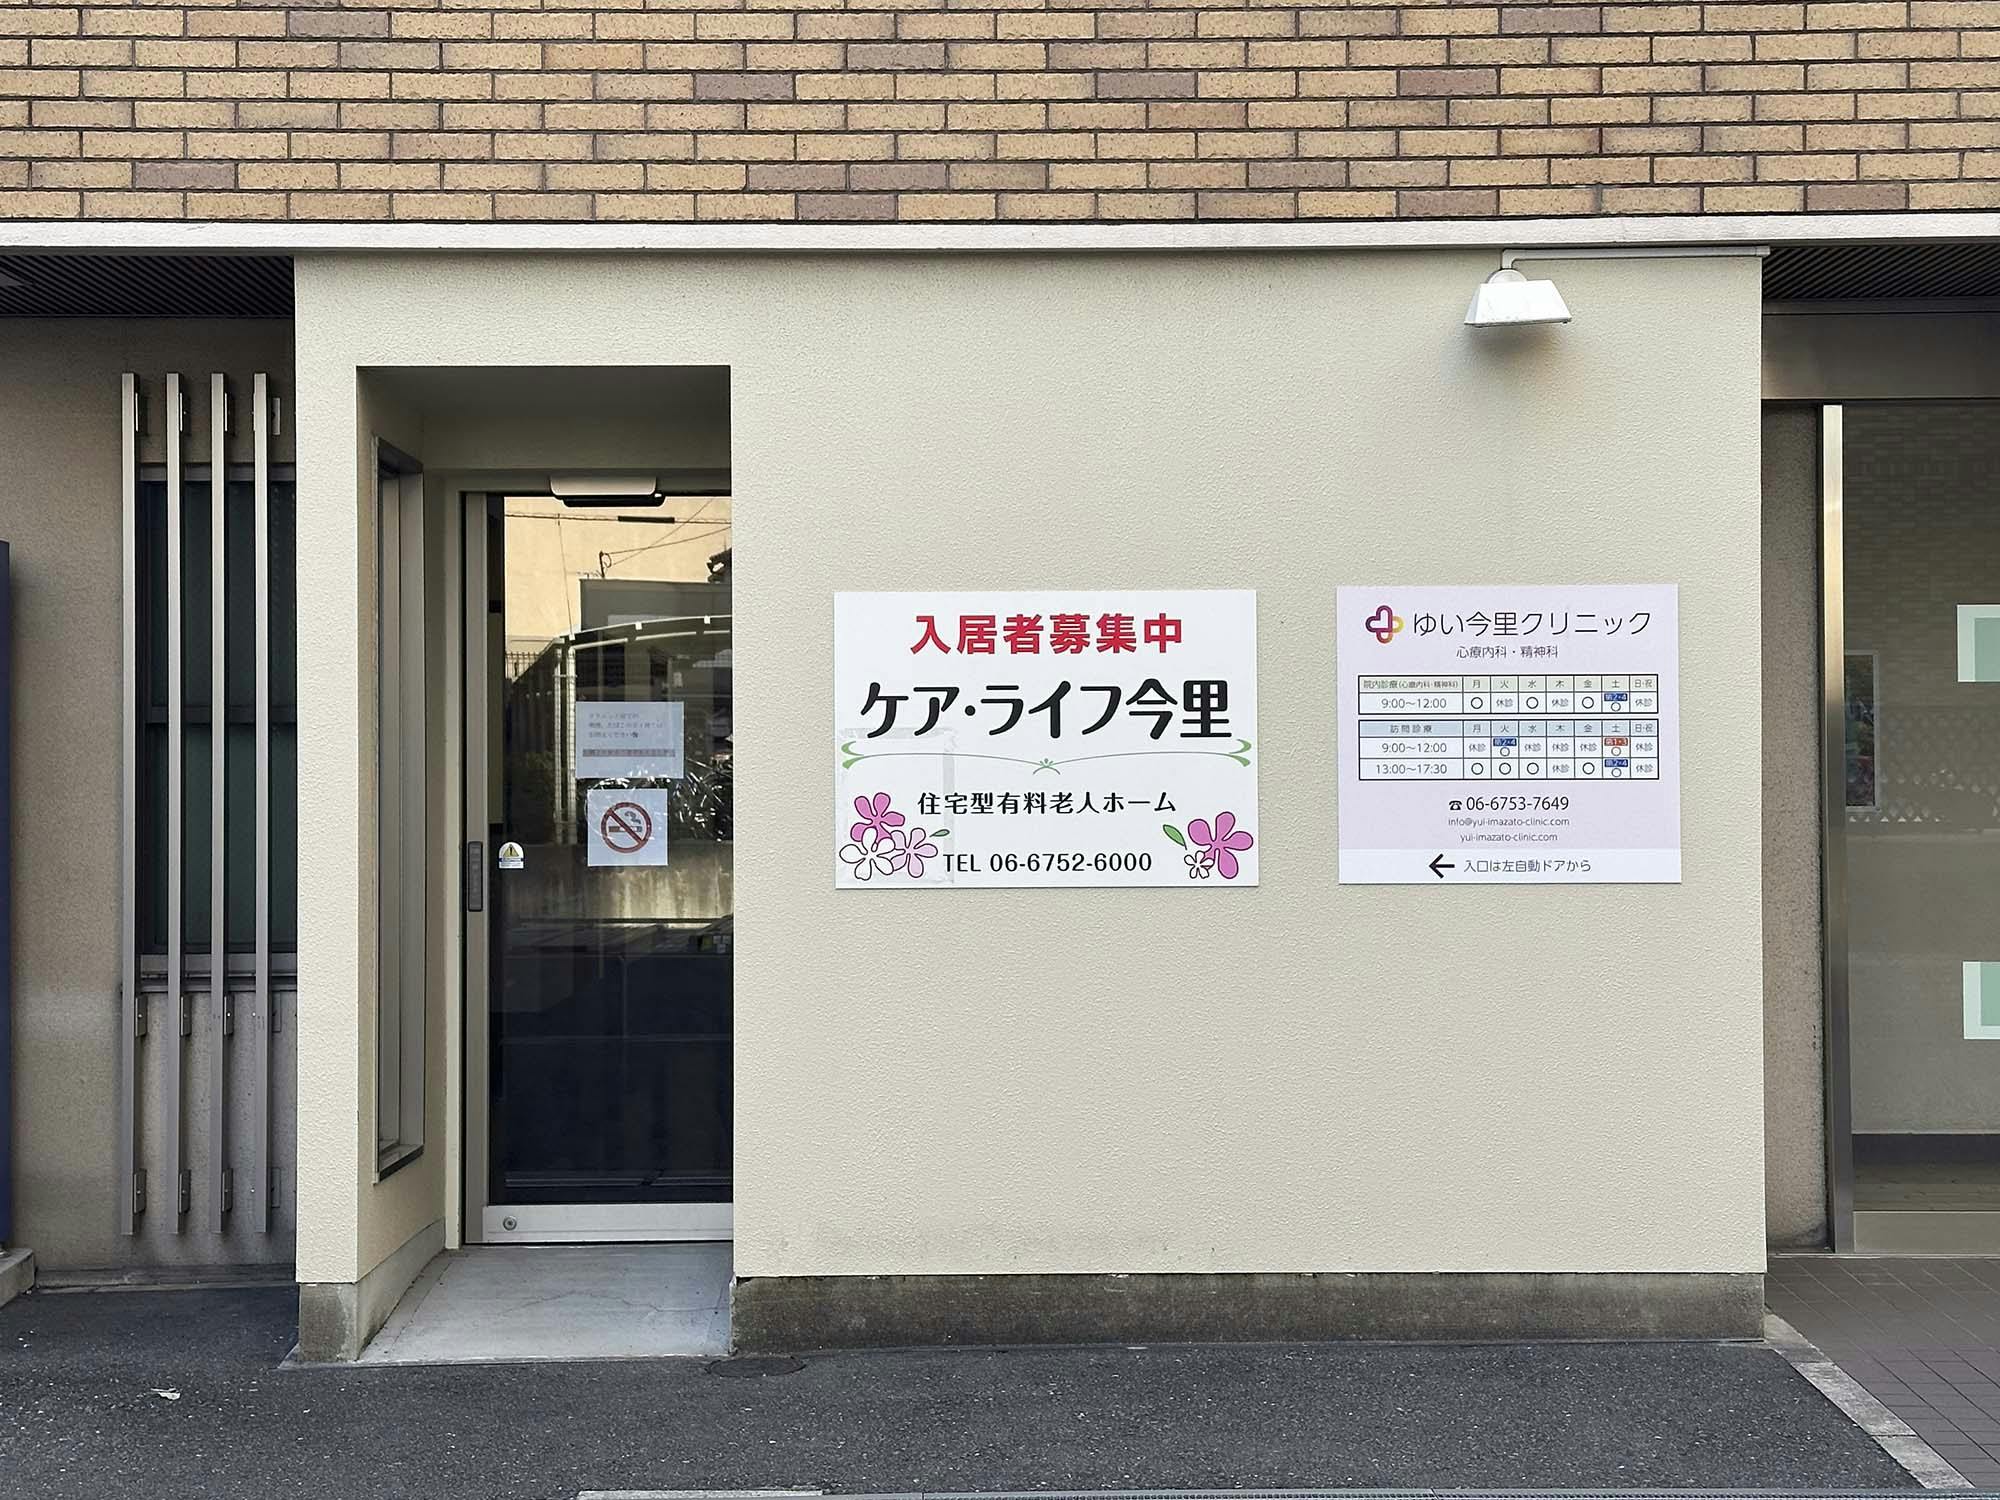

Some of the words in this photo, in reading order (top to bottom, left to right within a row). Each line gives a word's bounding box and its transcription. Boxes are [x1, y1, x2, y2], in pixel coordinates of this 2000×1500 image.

[1414, 611, 1650, 636] ゆい今里クリニック
[909, 612, 1184, 656] 入居者募集中
[1457, 646, 1558, 658] 心療内科・精神科
[1472, 680, 1480, 688] 月
[1500, 680, 1508, 688] 火
[1528, 680, 1536, 688] 水
[1583, 680, 1592, 688] 金
[1612, 680, 1619, 689] 土
[861, 678, 1232, 740] ケア・ライフ今里
[1472, 725, 1481, 733] 月
[1528, 724, 1536, 734] 水
[1556, 724, 1564, 732] 木
[1584, 724, 1592, 732] 金
[1612, 724, 1620, 732] 土
[918, 792, 1176, 815] 住宅型有料老人ホーム
[1467, 797, 1568, 810] 06-6753-7649
[1449, 817, 1569, 827] info@yui-imazato-clinic.com
[1458, 833, 1557, 842] yui-imazato-clinic.com
[943, 854, 981, 872] TEL
[990, 853, 1151, 872] 06-6752-6000
[1464, 860, 1591, 872] 入口は左自動ドアから
